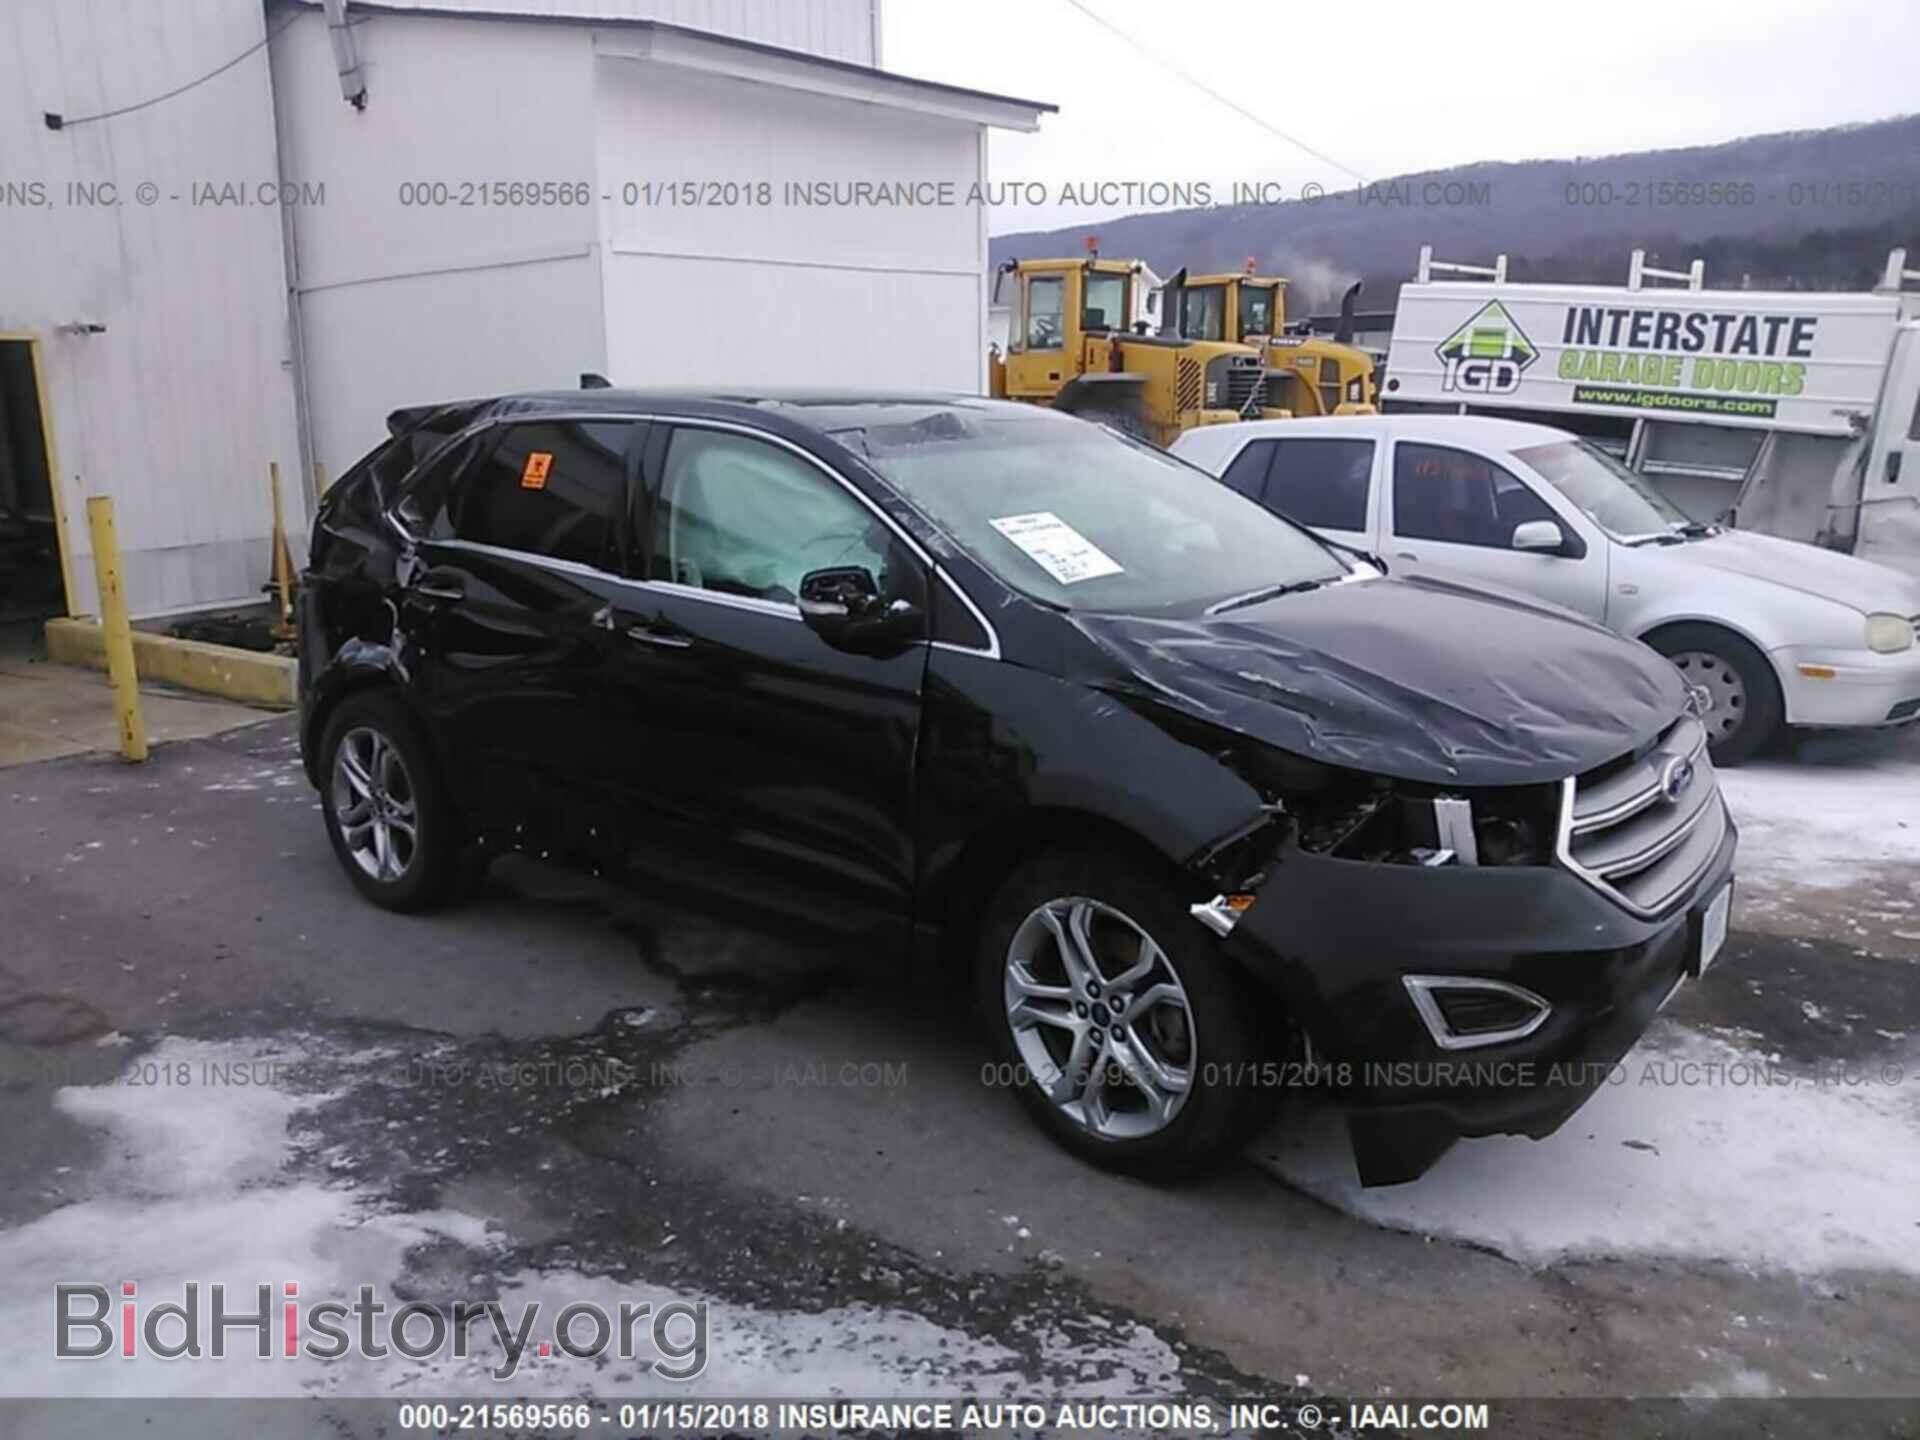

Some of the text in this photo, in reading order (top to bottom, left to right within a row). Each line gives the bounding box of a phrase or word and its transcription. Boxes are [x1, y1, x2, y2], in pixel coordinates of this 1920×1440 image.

[1563, 307, 1818, 358] INTERSTATE
[1442, 357, 1522, 395] IGD
[1558, 350, 1807, 397] GARAGE DOORS
[1577, 389, 1773, 415] www.igdoors.com
